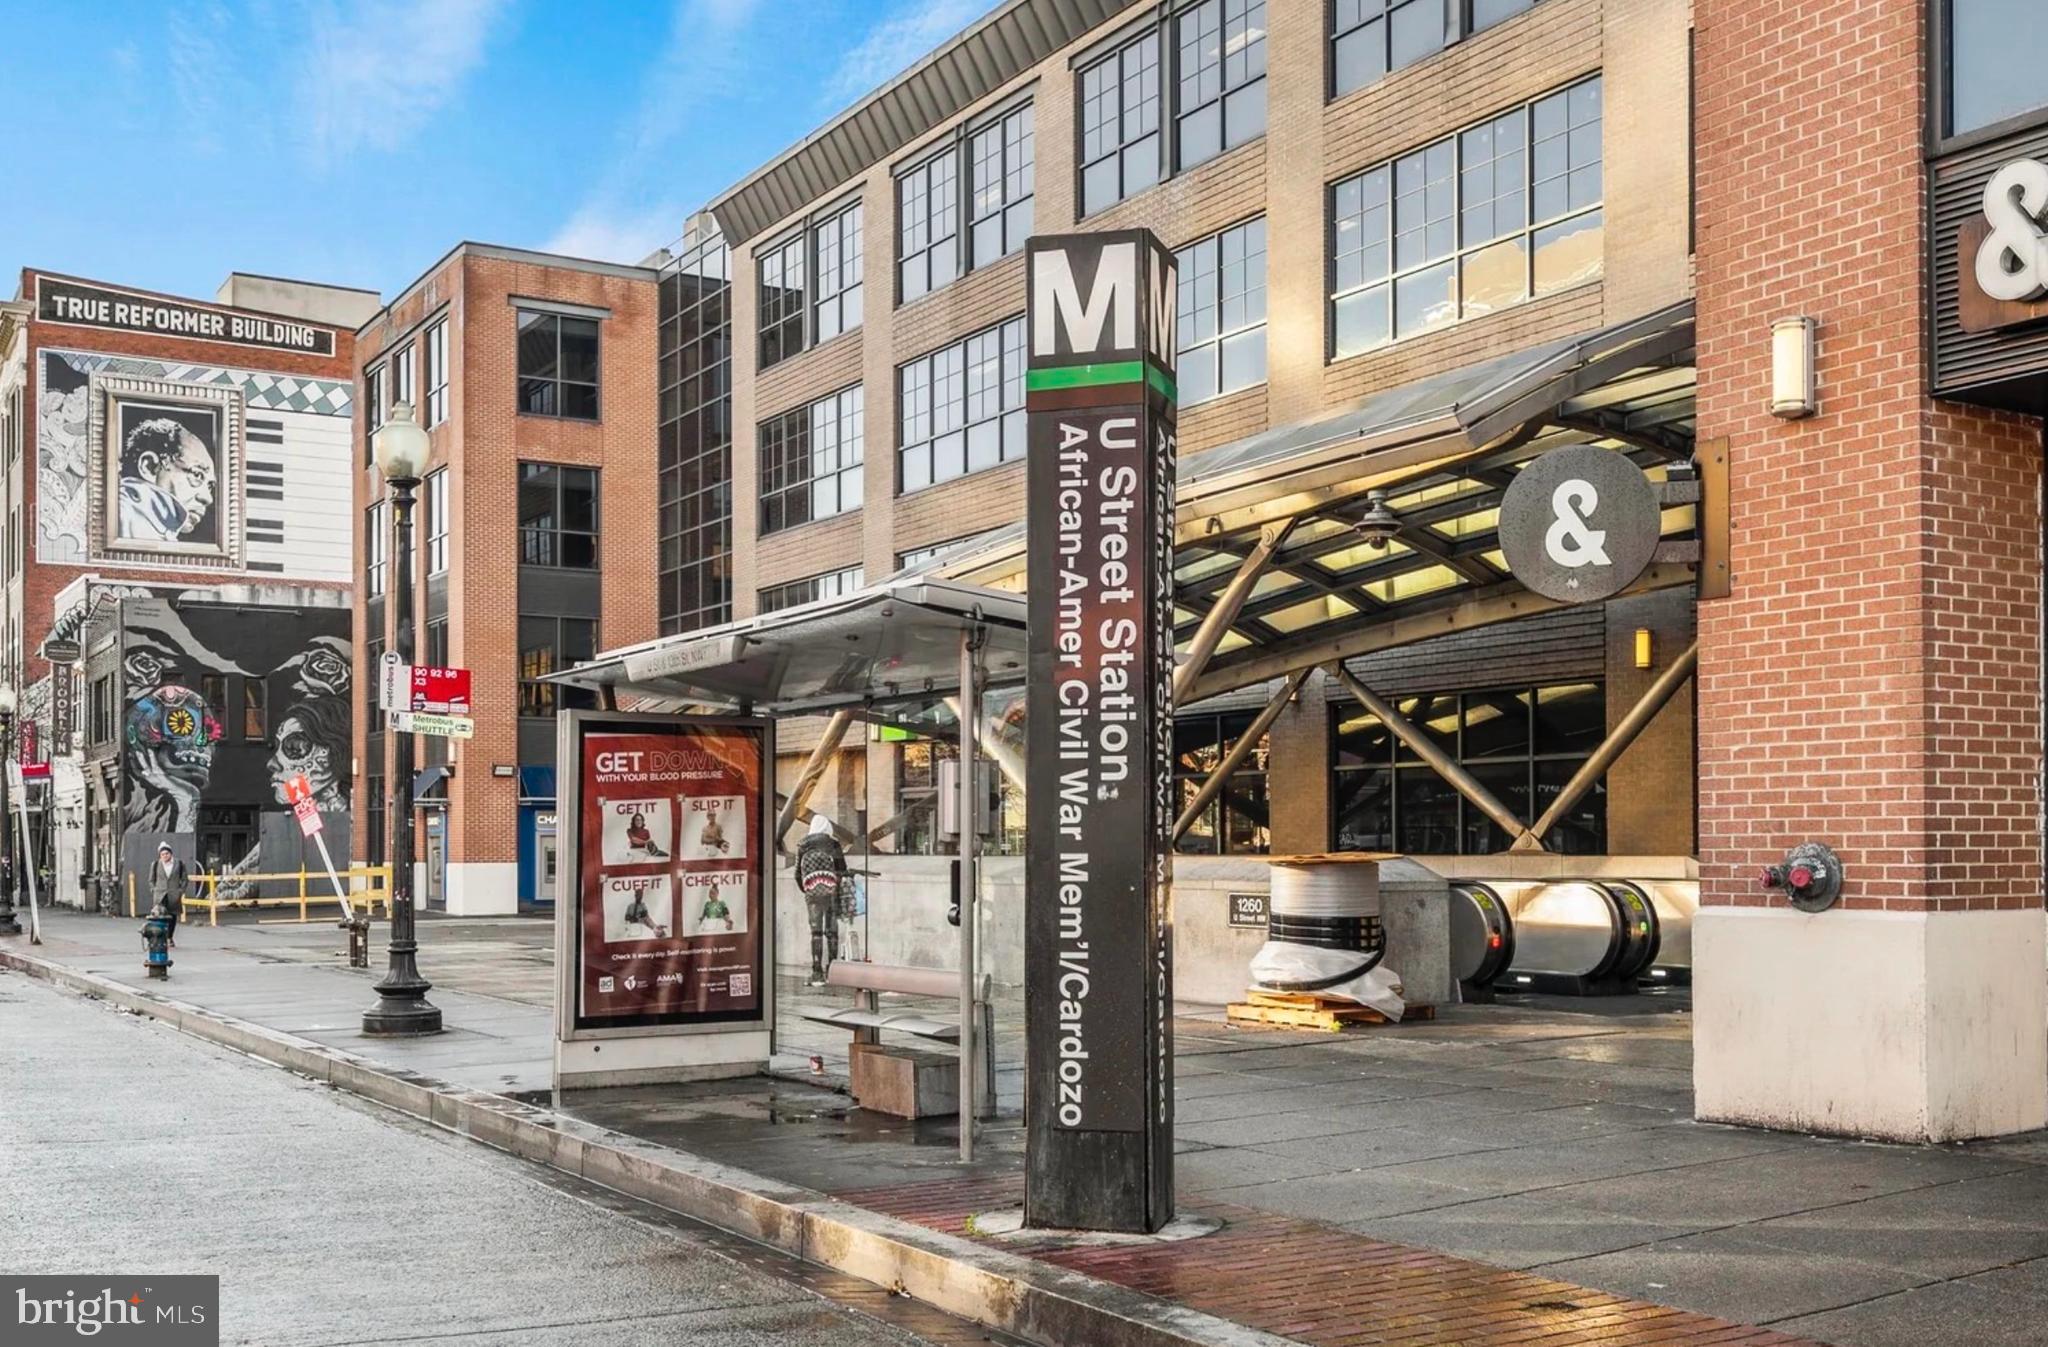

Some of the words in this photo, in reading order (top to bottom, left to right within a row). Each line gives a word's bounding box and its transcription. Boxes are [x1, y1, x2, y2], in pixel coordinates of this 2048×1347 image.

[1034, 242, 1136, 357] M
[1151, 246, 1177, 373] M
[52, 295, 110, 323] TRUE
[115, 303, 224, 336] REFORMER
[231, 317, 315, 347] BUILDING
[1099, 417, 1137, 449] U
[1099, 465, 1137, 605] Street
[1545, 478, 1612, 567] &
[1059, 422, 1088, 668] African-Amer
[1165, 479, 1176, 612] Street
[414, 668, 427, 677] 90
[430, 669, 442, 678] 92
[1099, 618, 1137, 782] Station
[391, 712, 400, 725] M
[413, 715, 454, 725] Metrobus
[413, 724, 454, 735] SHUTTLE
[1059, 679, 1089, 759] Civil
[596, 752, 644, 773] GET
[651, 750, 724, 772] DOWN
[596, 774, 621, 783] WITH
[623, 772, 648, 782] YOUR
[650, 772, 679, 781] BLOOD
[681, 770, 724, 780] PRESSURE
[616, 803, 642, 815] GET
[646, 802, 658, 814] IT
[692, 799, 720, 812] SLIP
[724, 799, 735, 811] IT
[1059, 768, 1089, 841] War
[1156, 776, 1166, 842] War
[612, 879, 649, 892] CUFF
[651, 878, 662, 890] IT
[685, 874, 730, 888] CHECK
[733, 873, 745, 885] IT
[1237, 898, 1263, 913] 1260
[657, 974, 677, 982] AMA
[1059, 853, 1089, 1127] Mem'l/Cardozo
